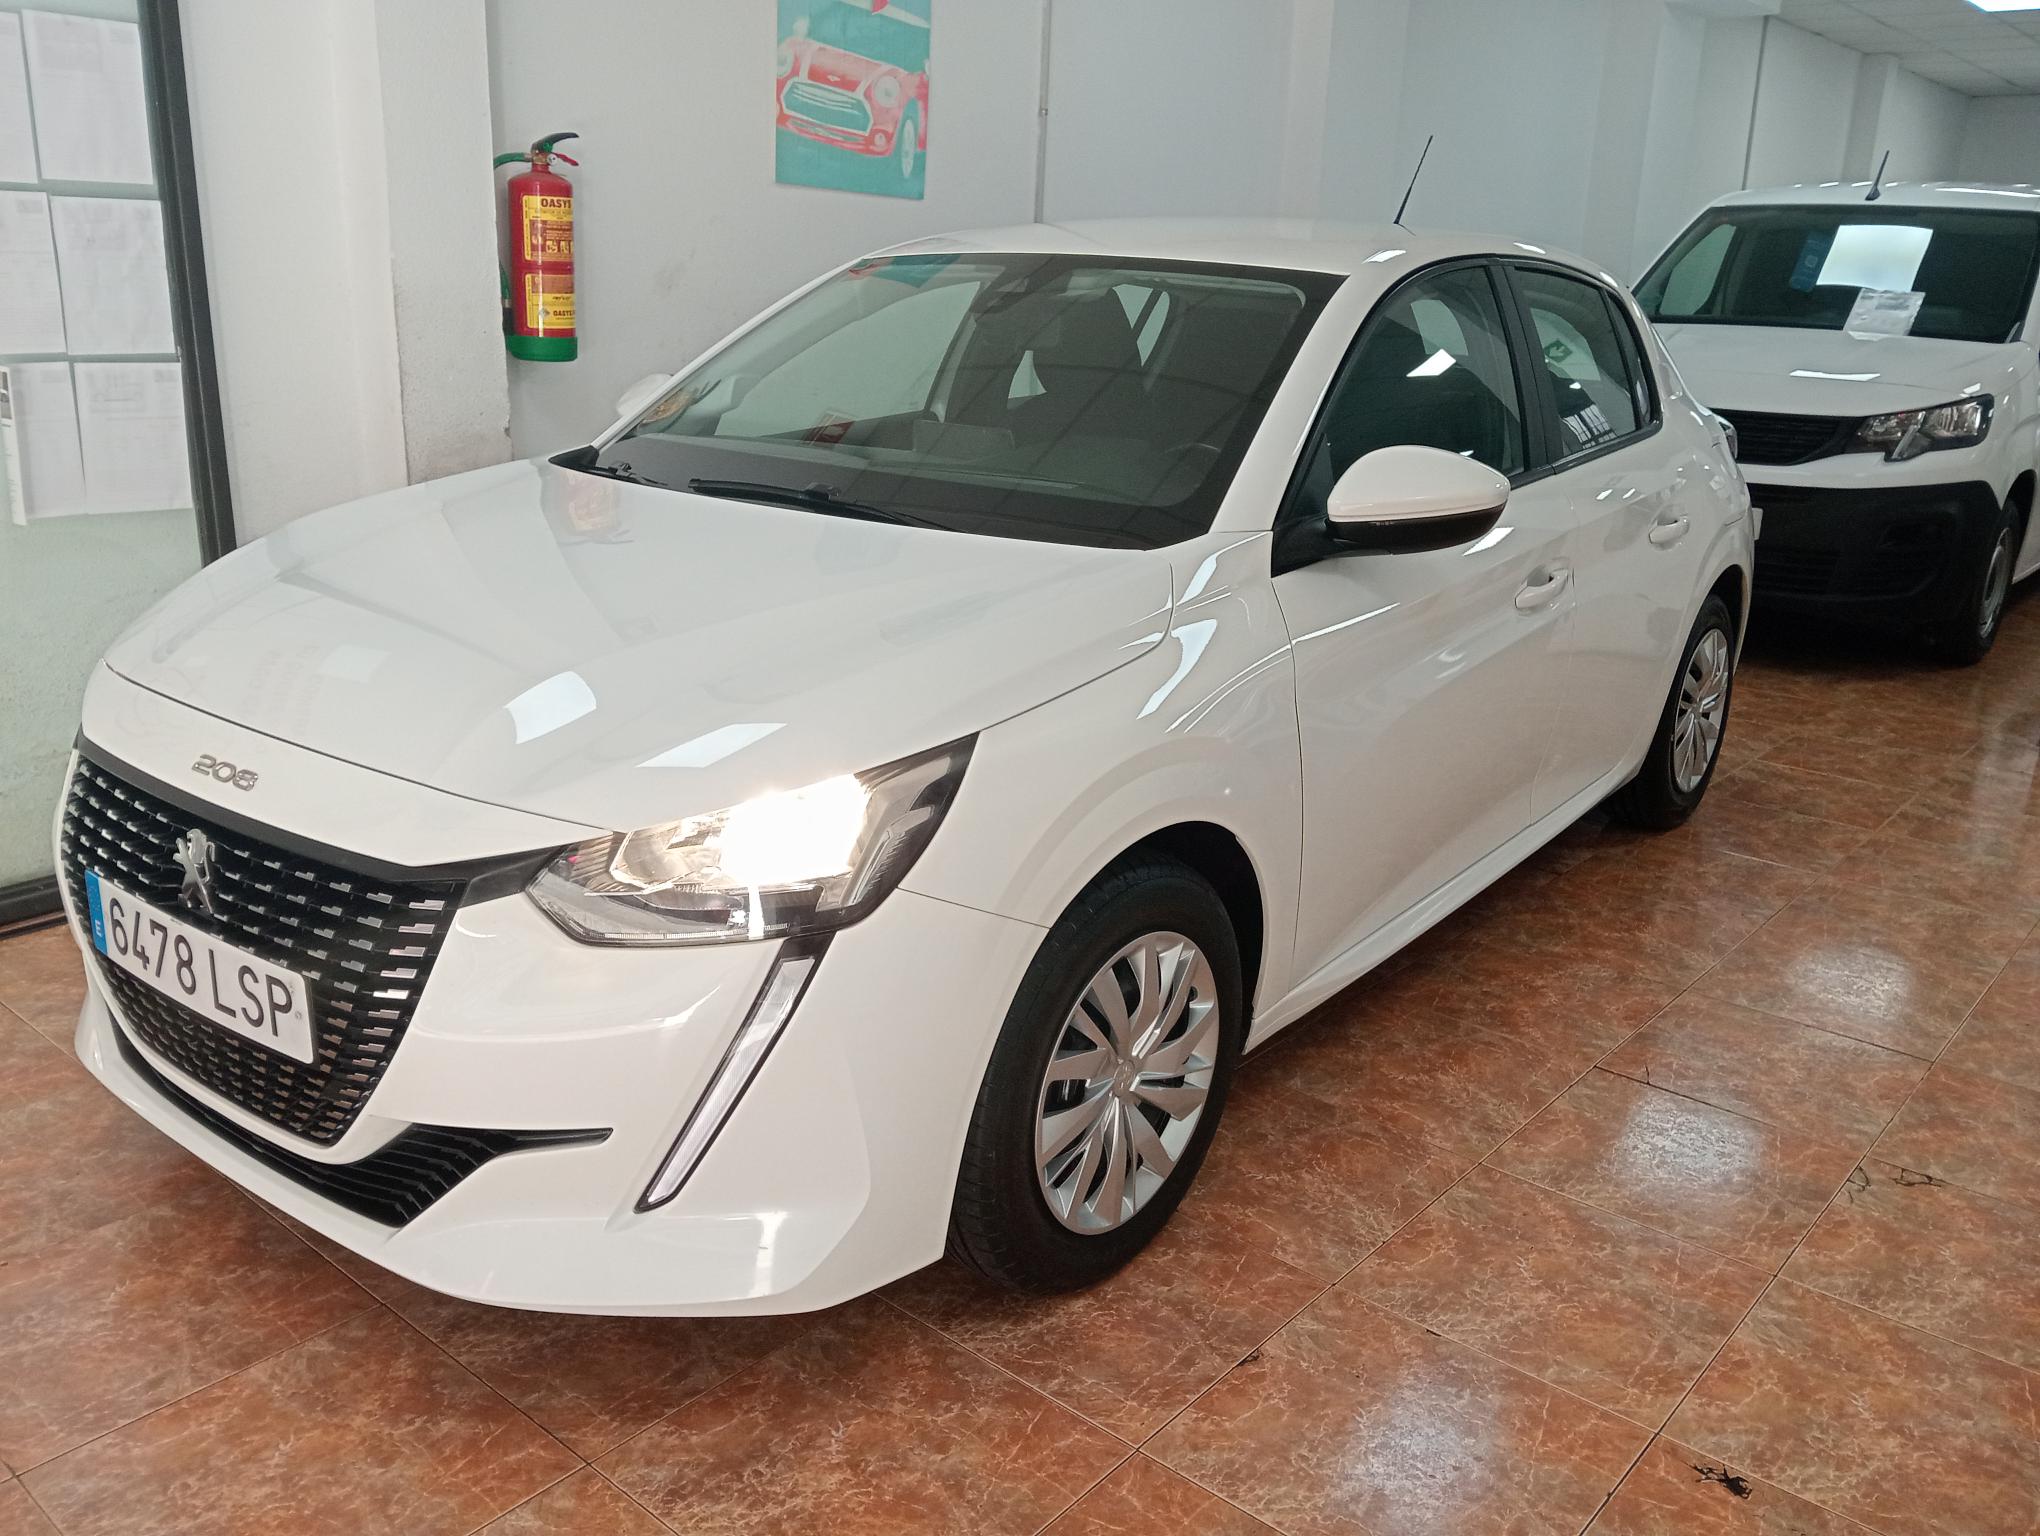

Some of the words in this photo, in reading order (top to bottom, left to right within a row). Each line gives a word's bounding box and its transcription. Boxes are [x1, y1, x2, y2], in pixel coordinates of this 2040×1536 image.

[192, 754, 258, 791] 208
[95, 919, 103, 937] E
[109, 897, 197, 996] 6478
[208, 948, 293, 1037] LSP
